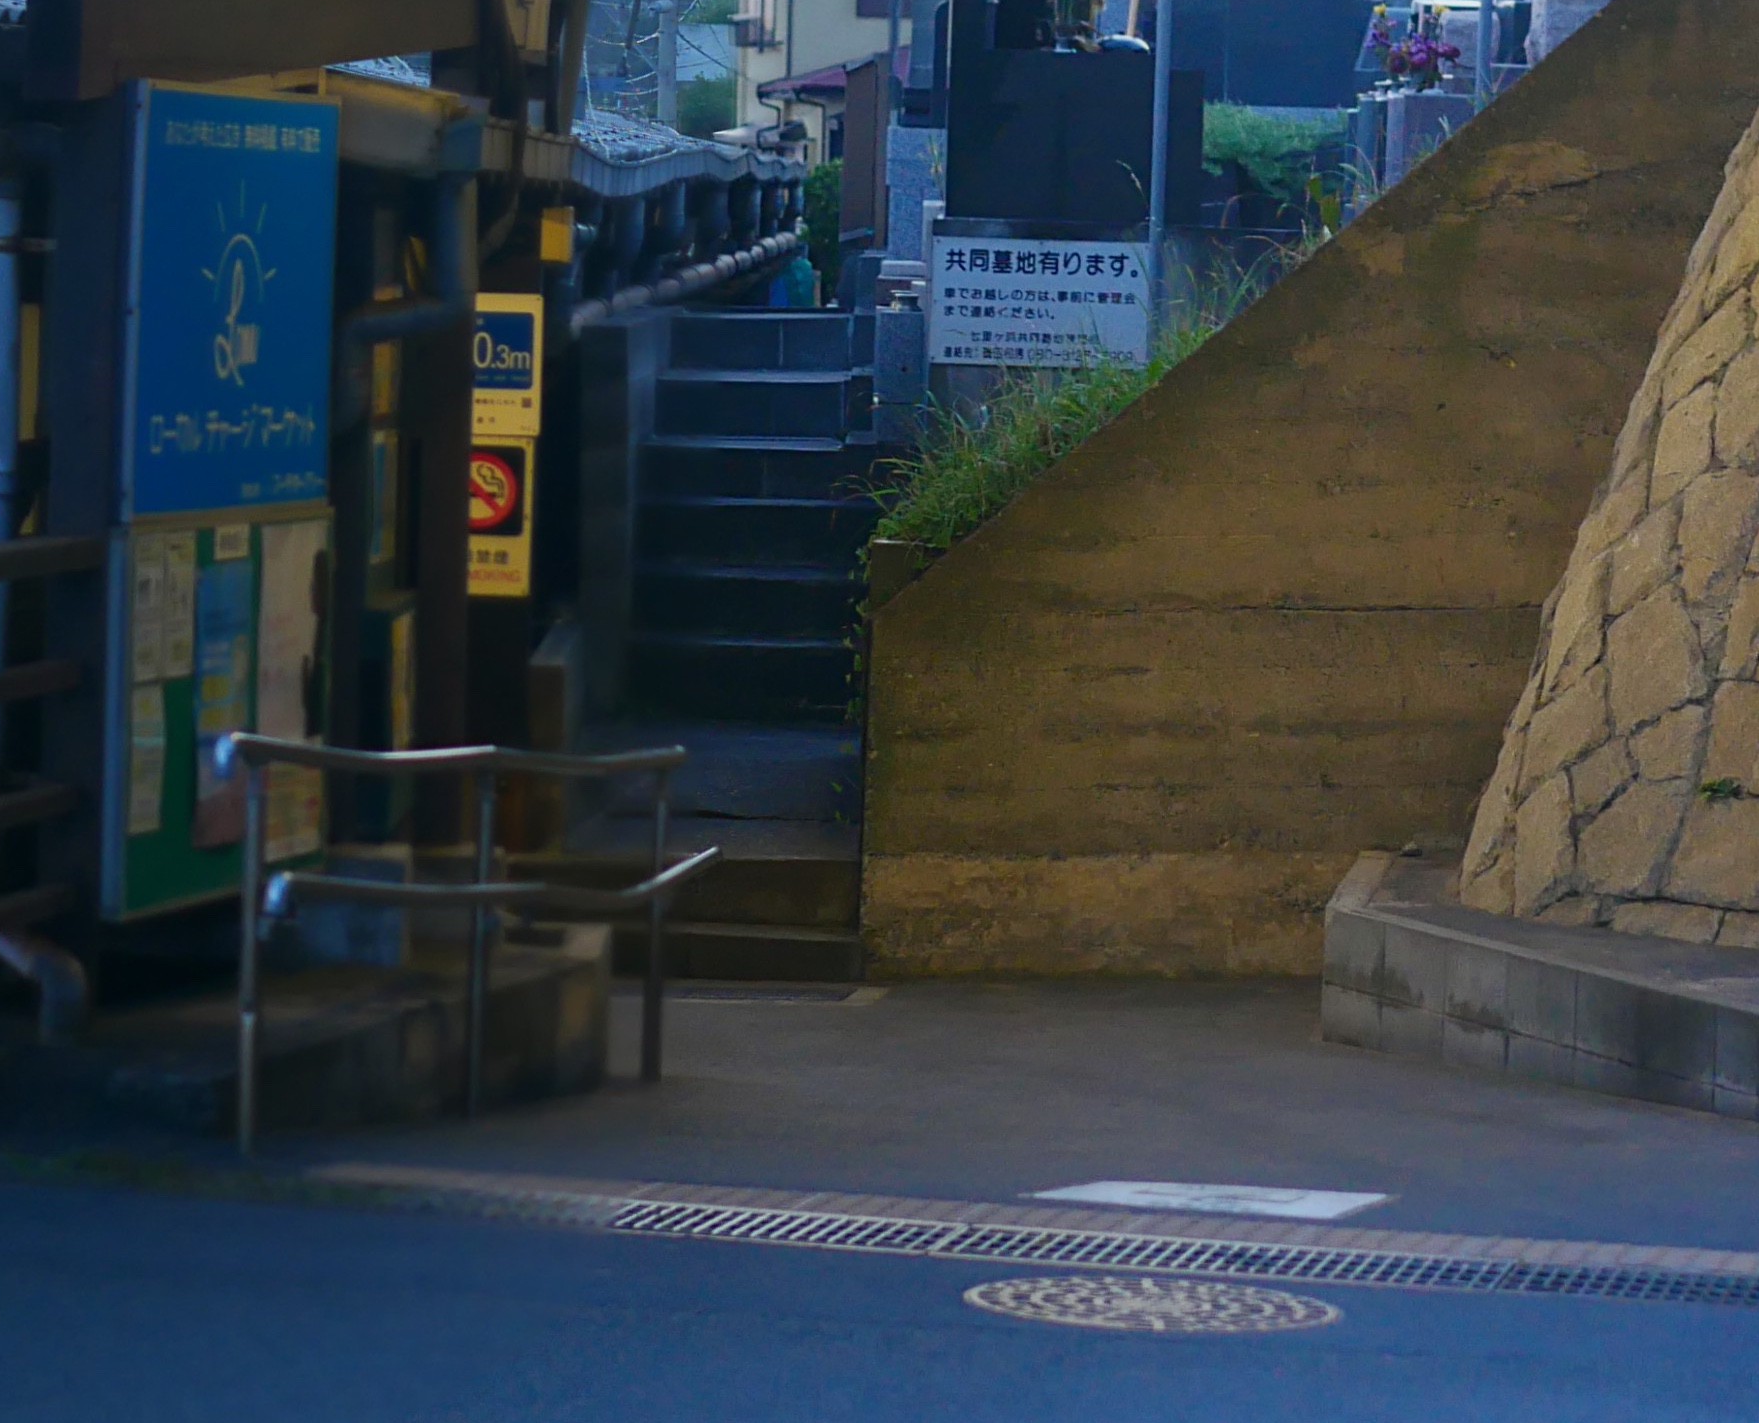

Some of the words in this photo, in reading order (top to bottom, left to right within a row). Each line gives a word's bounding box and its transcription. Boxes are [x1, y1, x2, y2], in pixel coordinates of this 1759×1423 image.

[944, 248, 1139, 278] 共同墓地有ります。
